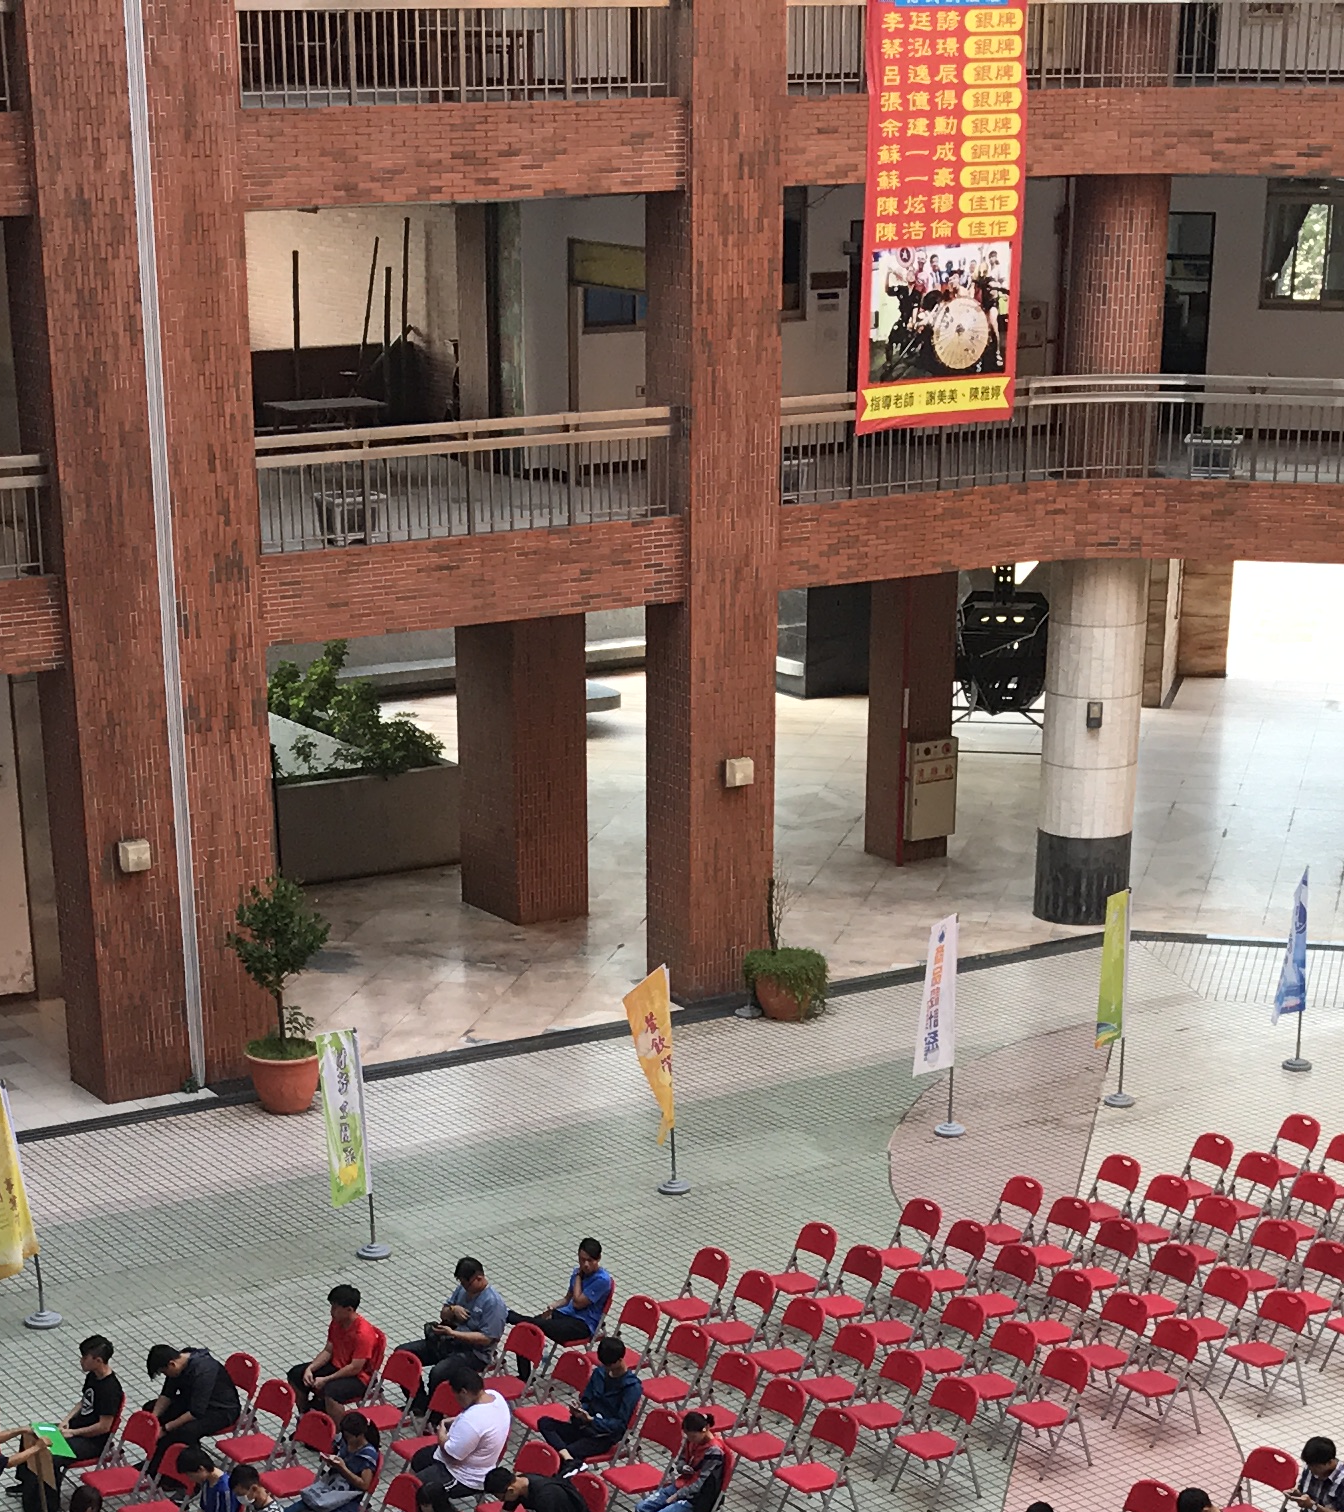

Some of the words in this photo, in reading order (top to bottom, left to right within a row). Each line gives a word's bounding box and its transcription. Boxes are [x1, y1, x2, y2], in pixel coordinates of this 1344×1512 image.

[975, 11, 1016, 29] 銀牌
[974, 38, 1015, 55] 銀牌
[973, 64, 1014, 81] 銀牌
[972, 90, 1013, 107] 銀牌
[971, 117, 1012, 134] 銀牌
[971, 143, 1010, 160] 銅牌
[969, 168, 1010, 185] 銅牌
[969, 195, 1010, 211] 佳作
[968, 220, 1008, 236] 佳作
